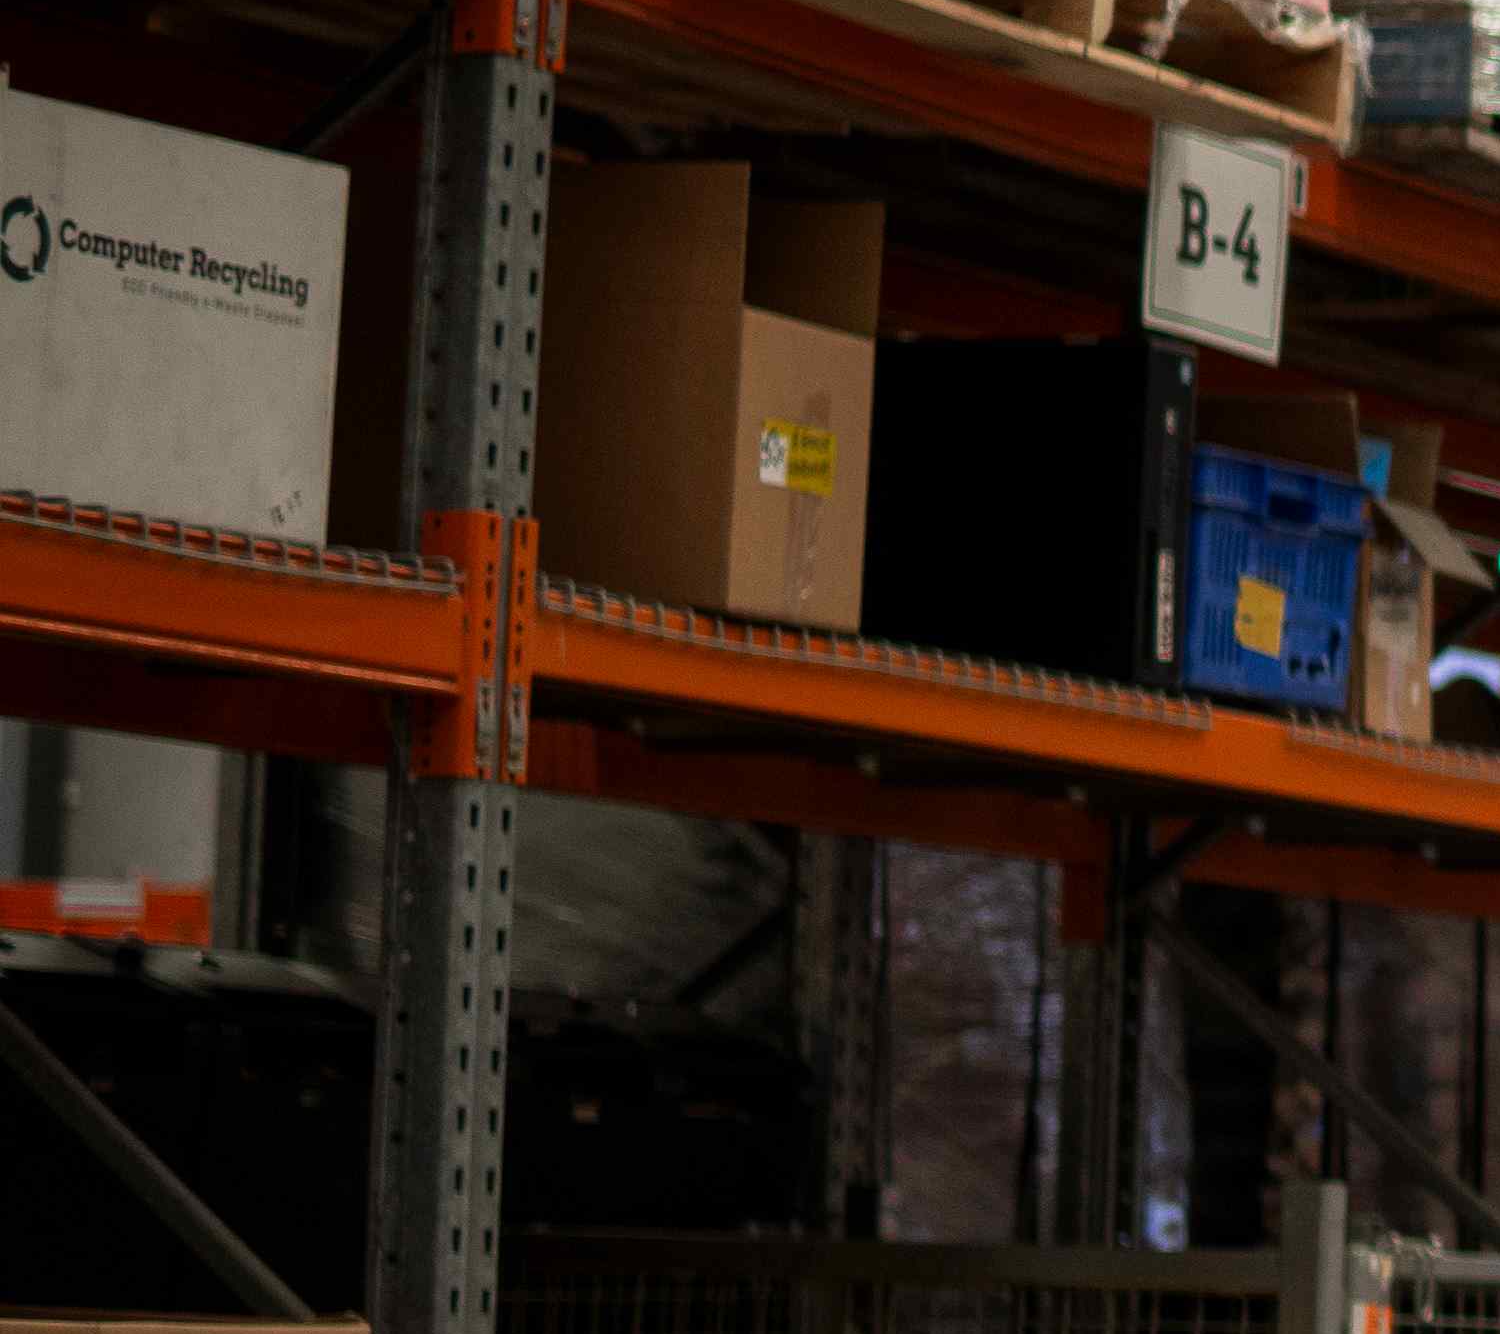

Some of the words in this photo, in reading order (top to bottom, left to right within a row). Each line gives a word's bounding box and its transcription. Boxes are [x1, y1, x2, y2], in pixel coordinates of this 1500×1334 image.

[59, 218, 184, 273] Computer
[190, 246, 310, 307] Recycling
[1177, 183, 1260, 285] B-4
